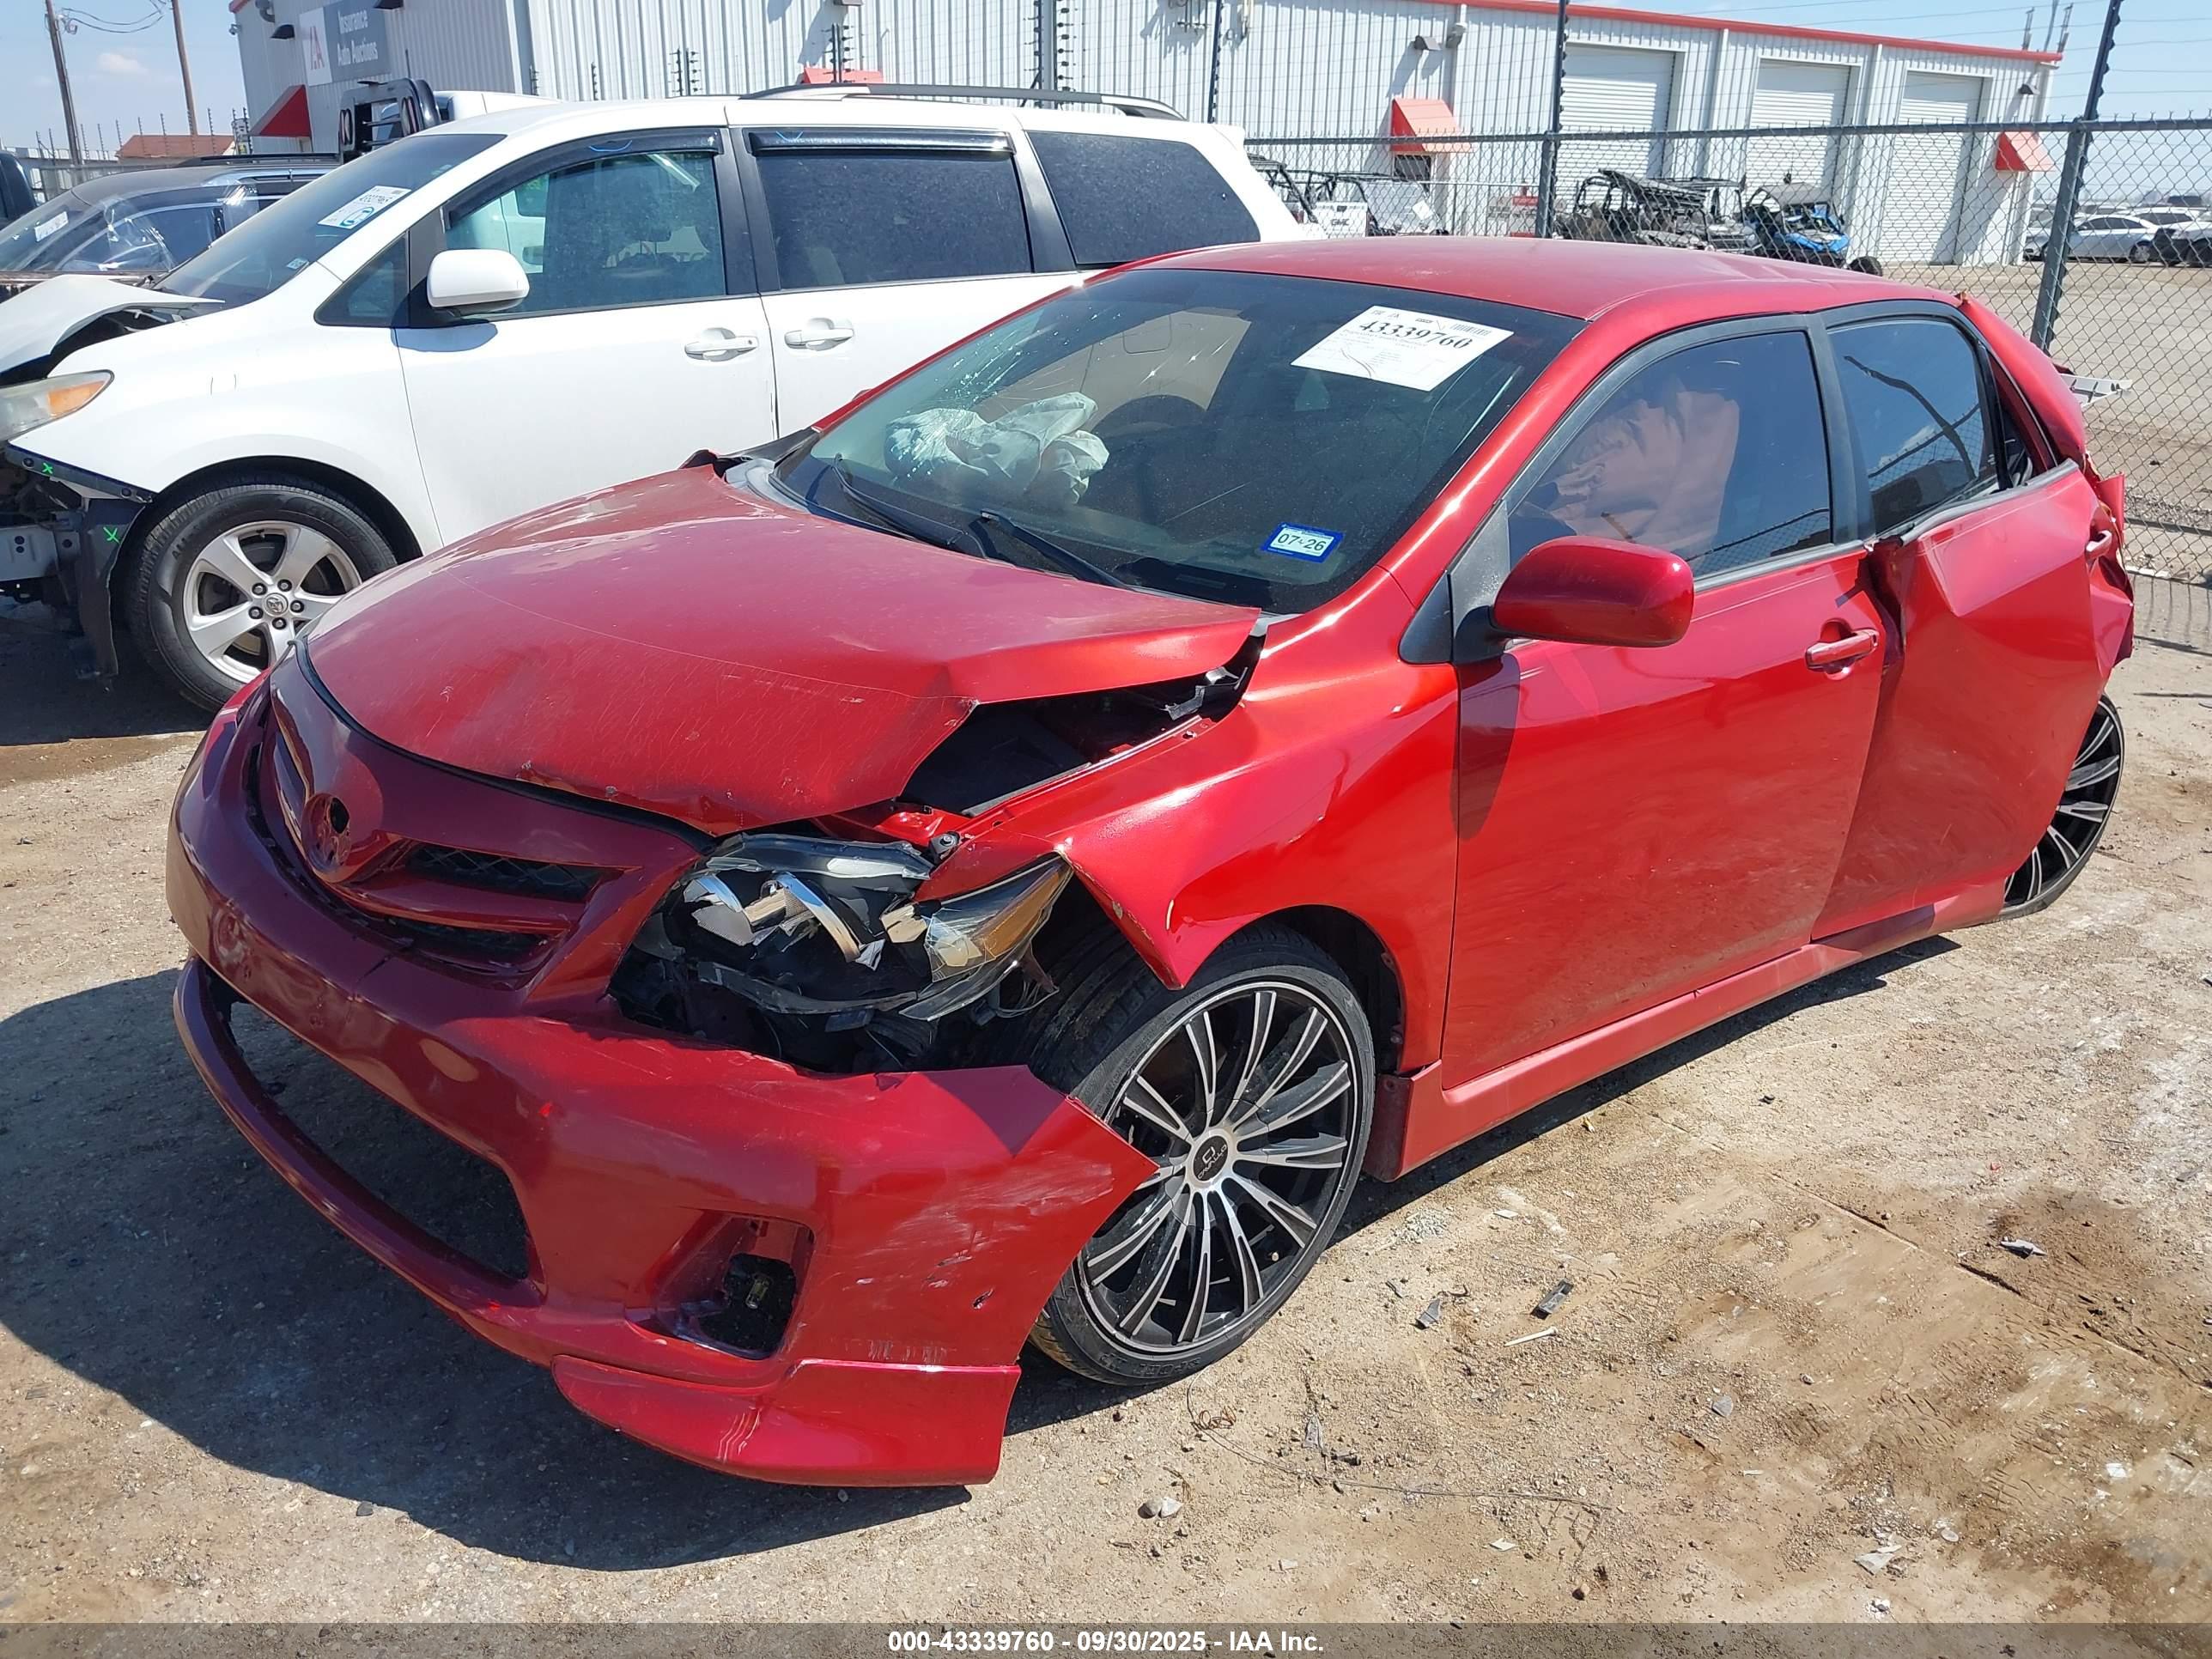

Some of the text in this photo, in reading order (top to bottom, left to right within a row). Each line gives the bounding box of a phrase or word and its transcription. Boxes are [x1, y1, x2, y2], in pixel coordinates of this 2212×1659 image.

[337, 9, 368, 34] Insurance
[337, 37, 379, 66] Auto Auctions
[1358, 320, 1473, 349] 43339760
